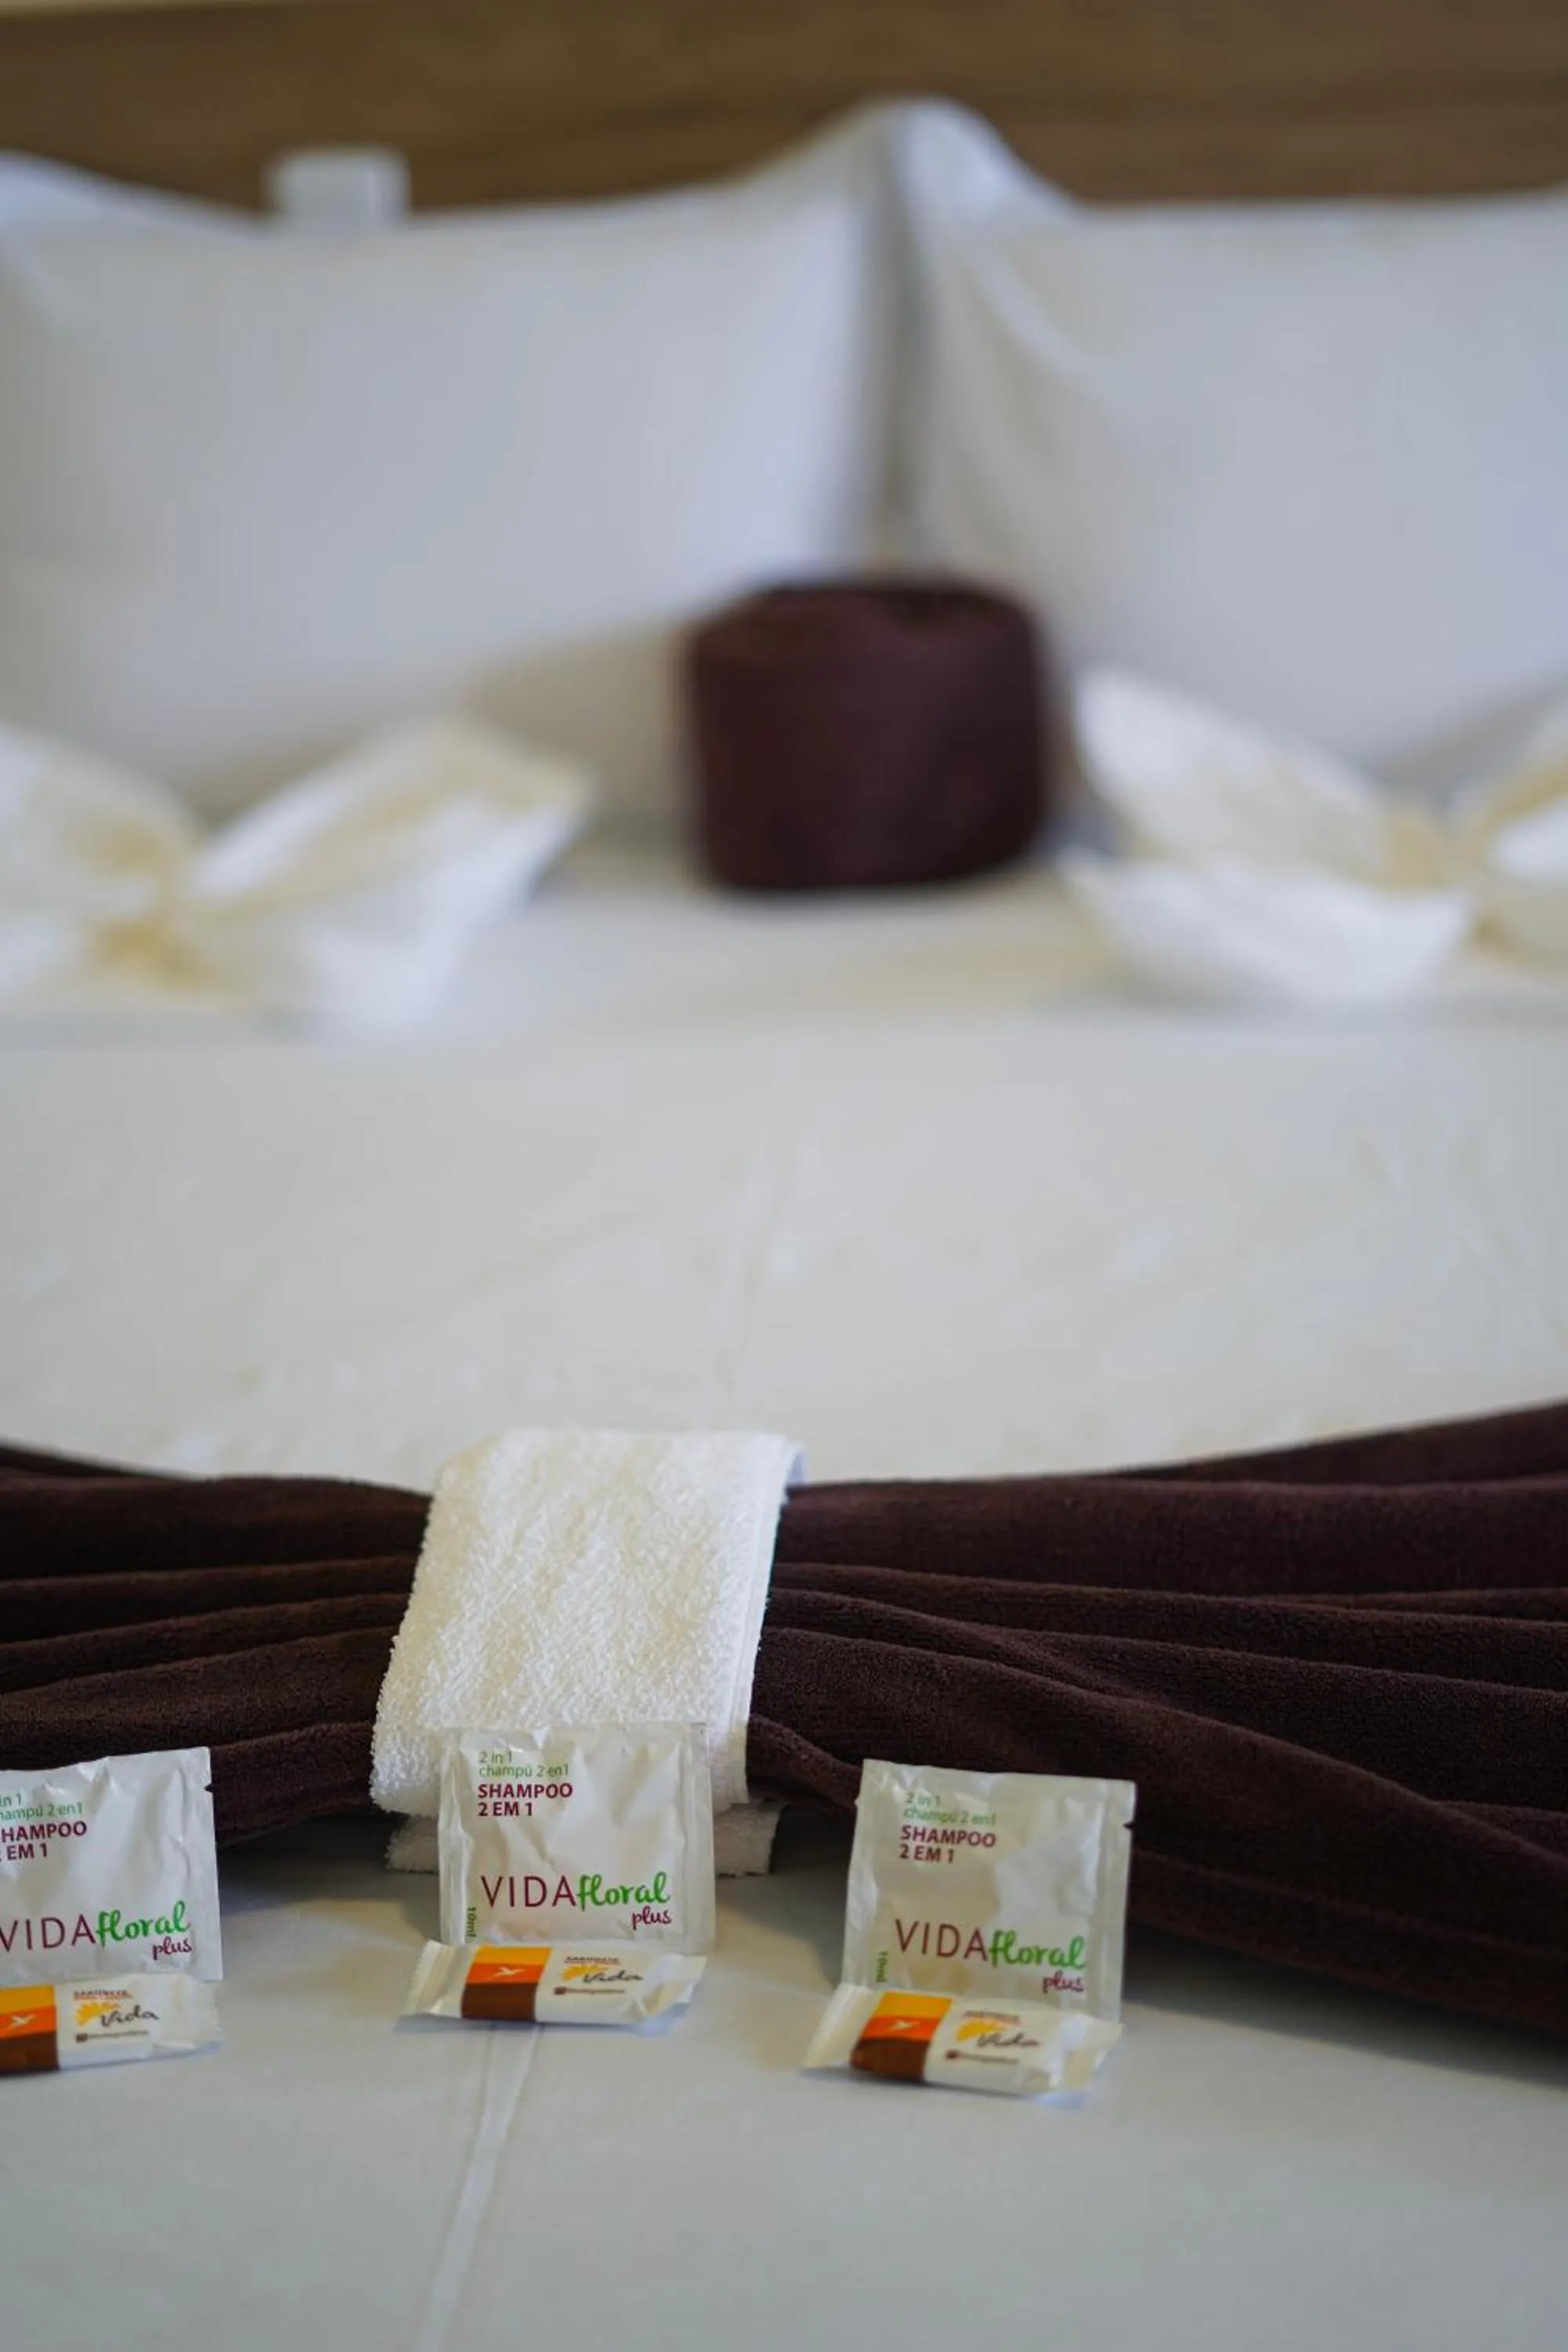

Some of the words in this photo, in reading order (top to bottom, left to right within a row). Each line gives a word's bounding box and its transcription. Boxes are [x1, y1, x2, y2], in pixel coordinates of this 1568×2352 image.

[492, 1749, 503, 1763] in
[477, 1782, 573, 1799] SHAMPOO
[477, 1802, 488, 1817] 2
[492, 1801, 519, 1817] EM
[524, 1802, 532, 1816] 1
[0, 1820, 87, 1843] HAMPOO
[901, 1824, 996, 1848] SHAMPOO
[6, 1842, 34, 1861] EM
[39, 1842, 48, 1858] 1
[899, 1843, 909, 1860] 2
[913, 1845, 942, 1863] EM
[948, 1848, 954, 1864] 1
[631, 1905, 672, 1930] plus
[152, 1936, 193, 1961] plus
[1041, 1969, 1085, 1994] plus
